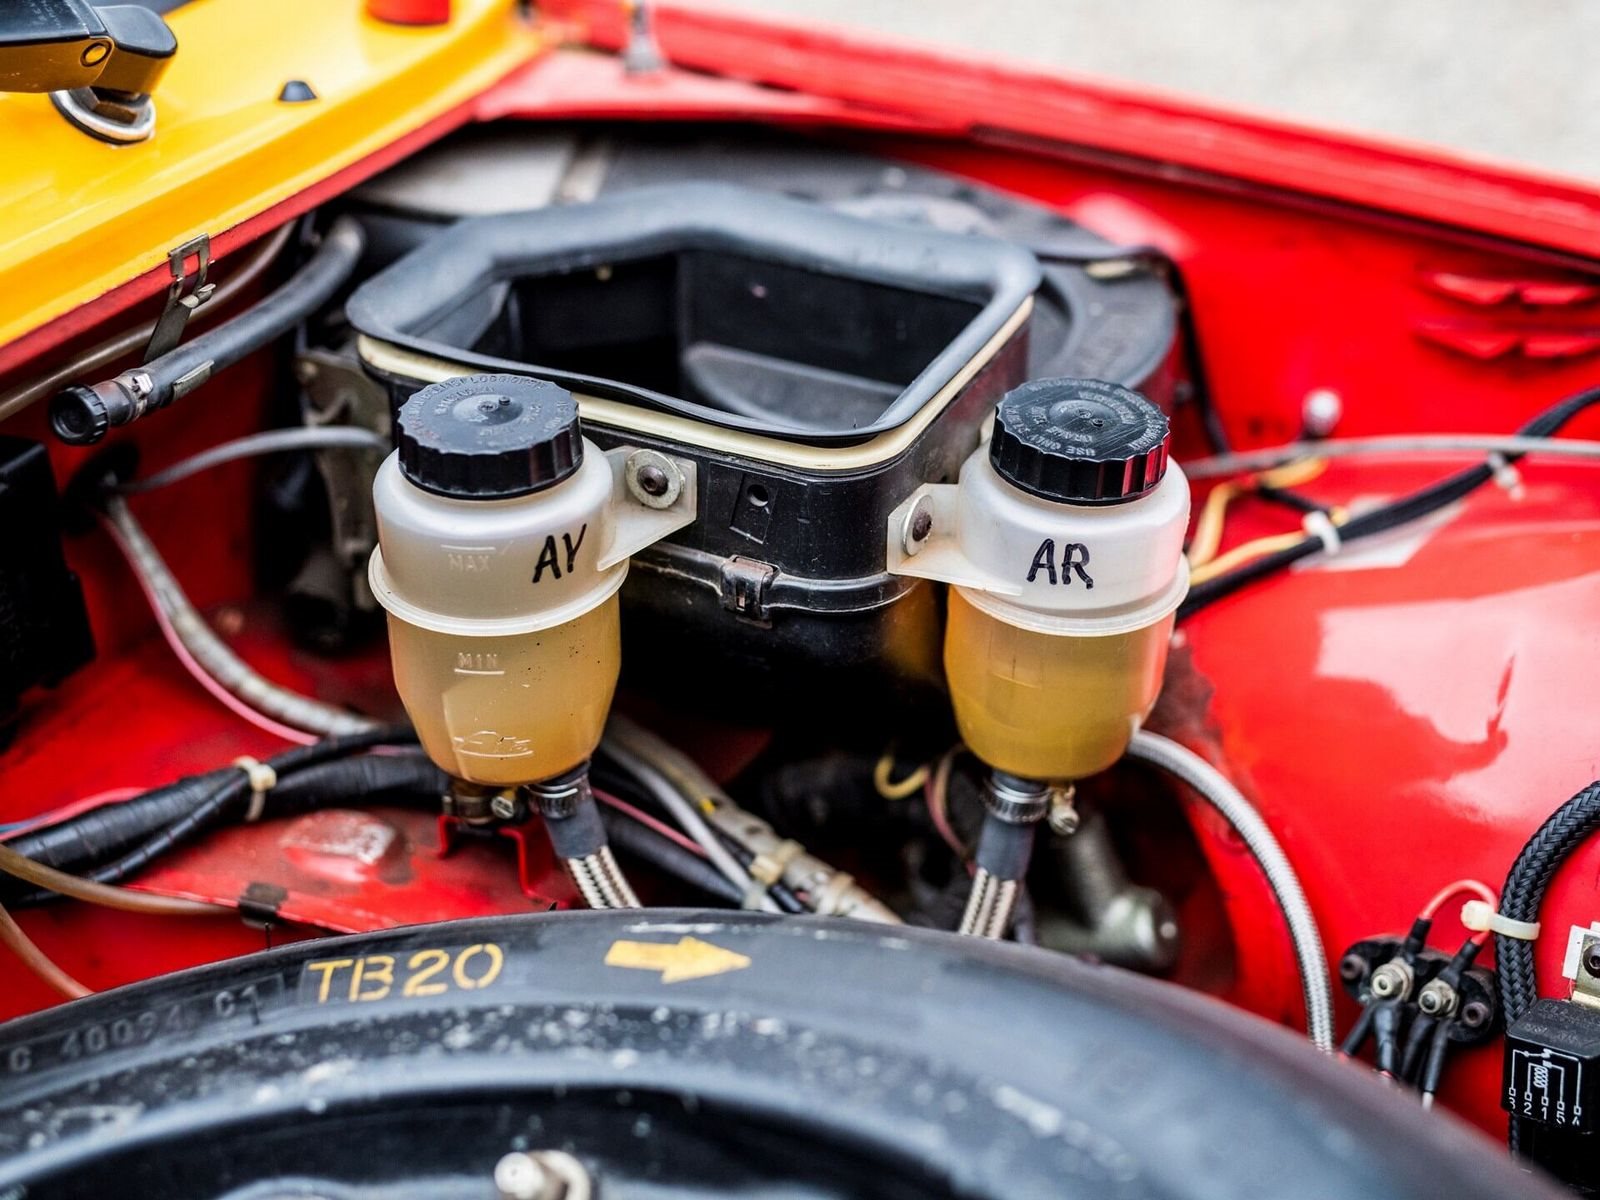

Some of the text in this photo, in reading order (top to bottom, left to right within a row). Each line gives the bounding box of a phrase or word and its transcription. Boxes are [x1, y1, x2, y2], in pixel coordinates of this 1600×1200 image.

[1029, 433, 1096, 457] USE ONLY
[448, 554, 490, 572] MAX
[532, 523, 588, 584] AY
[1026, 538, 1094, 590] AR
[458, 652, 498, 668] MIN
[308, 943, 504, 1003] TB20
[1523, 1102, 1532, 1116] 2
[1541, 1107, 1548, 1120] 1
